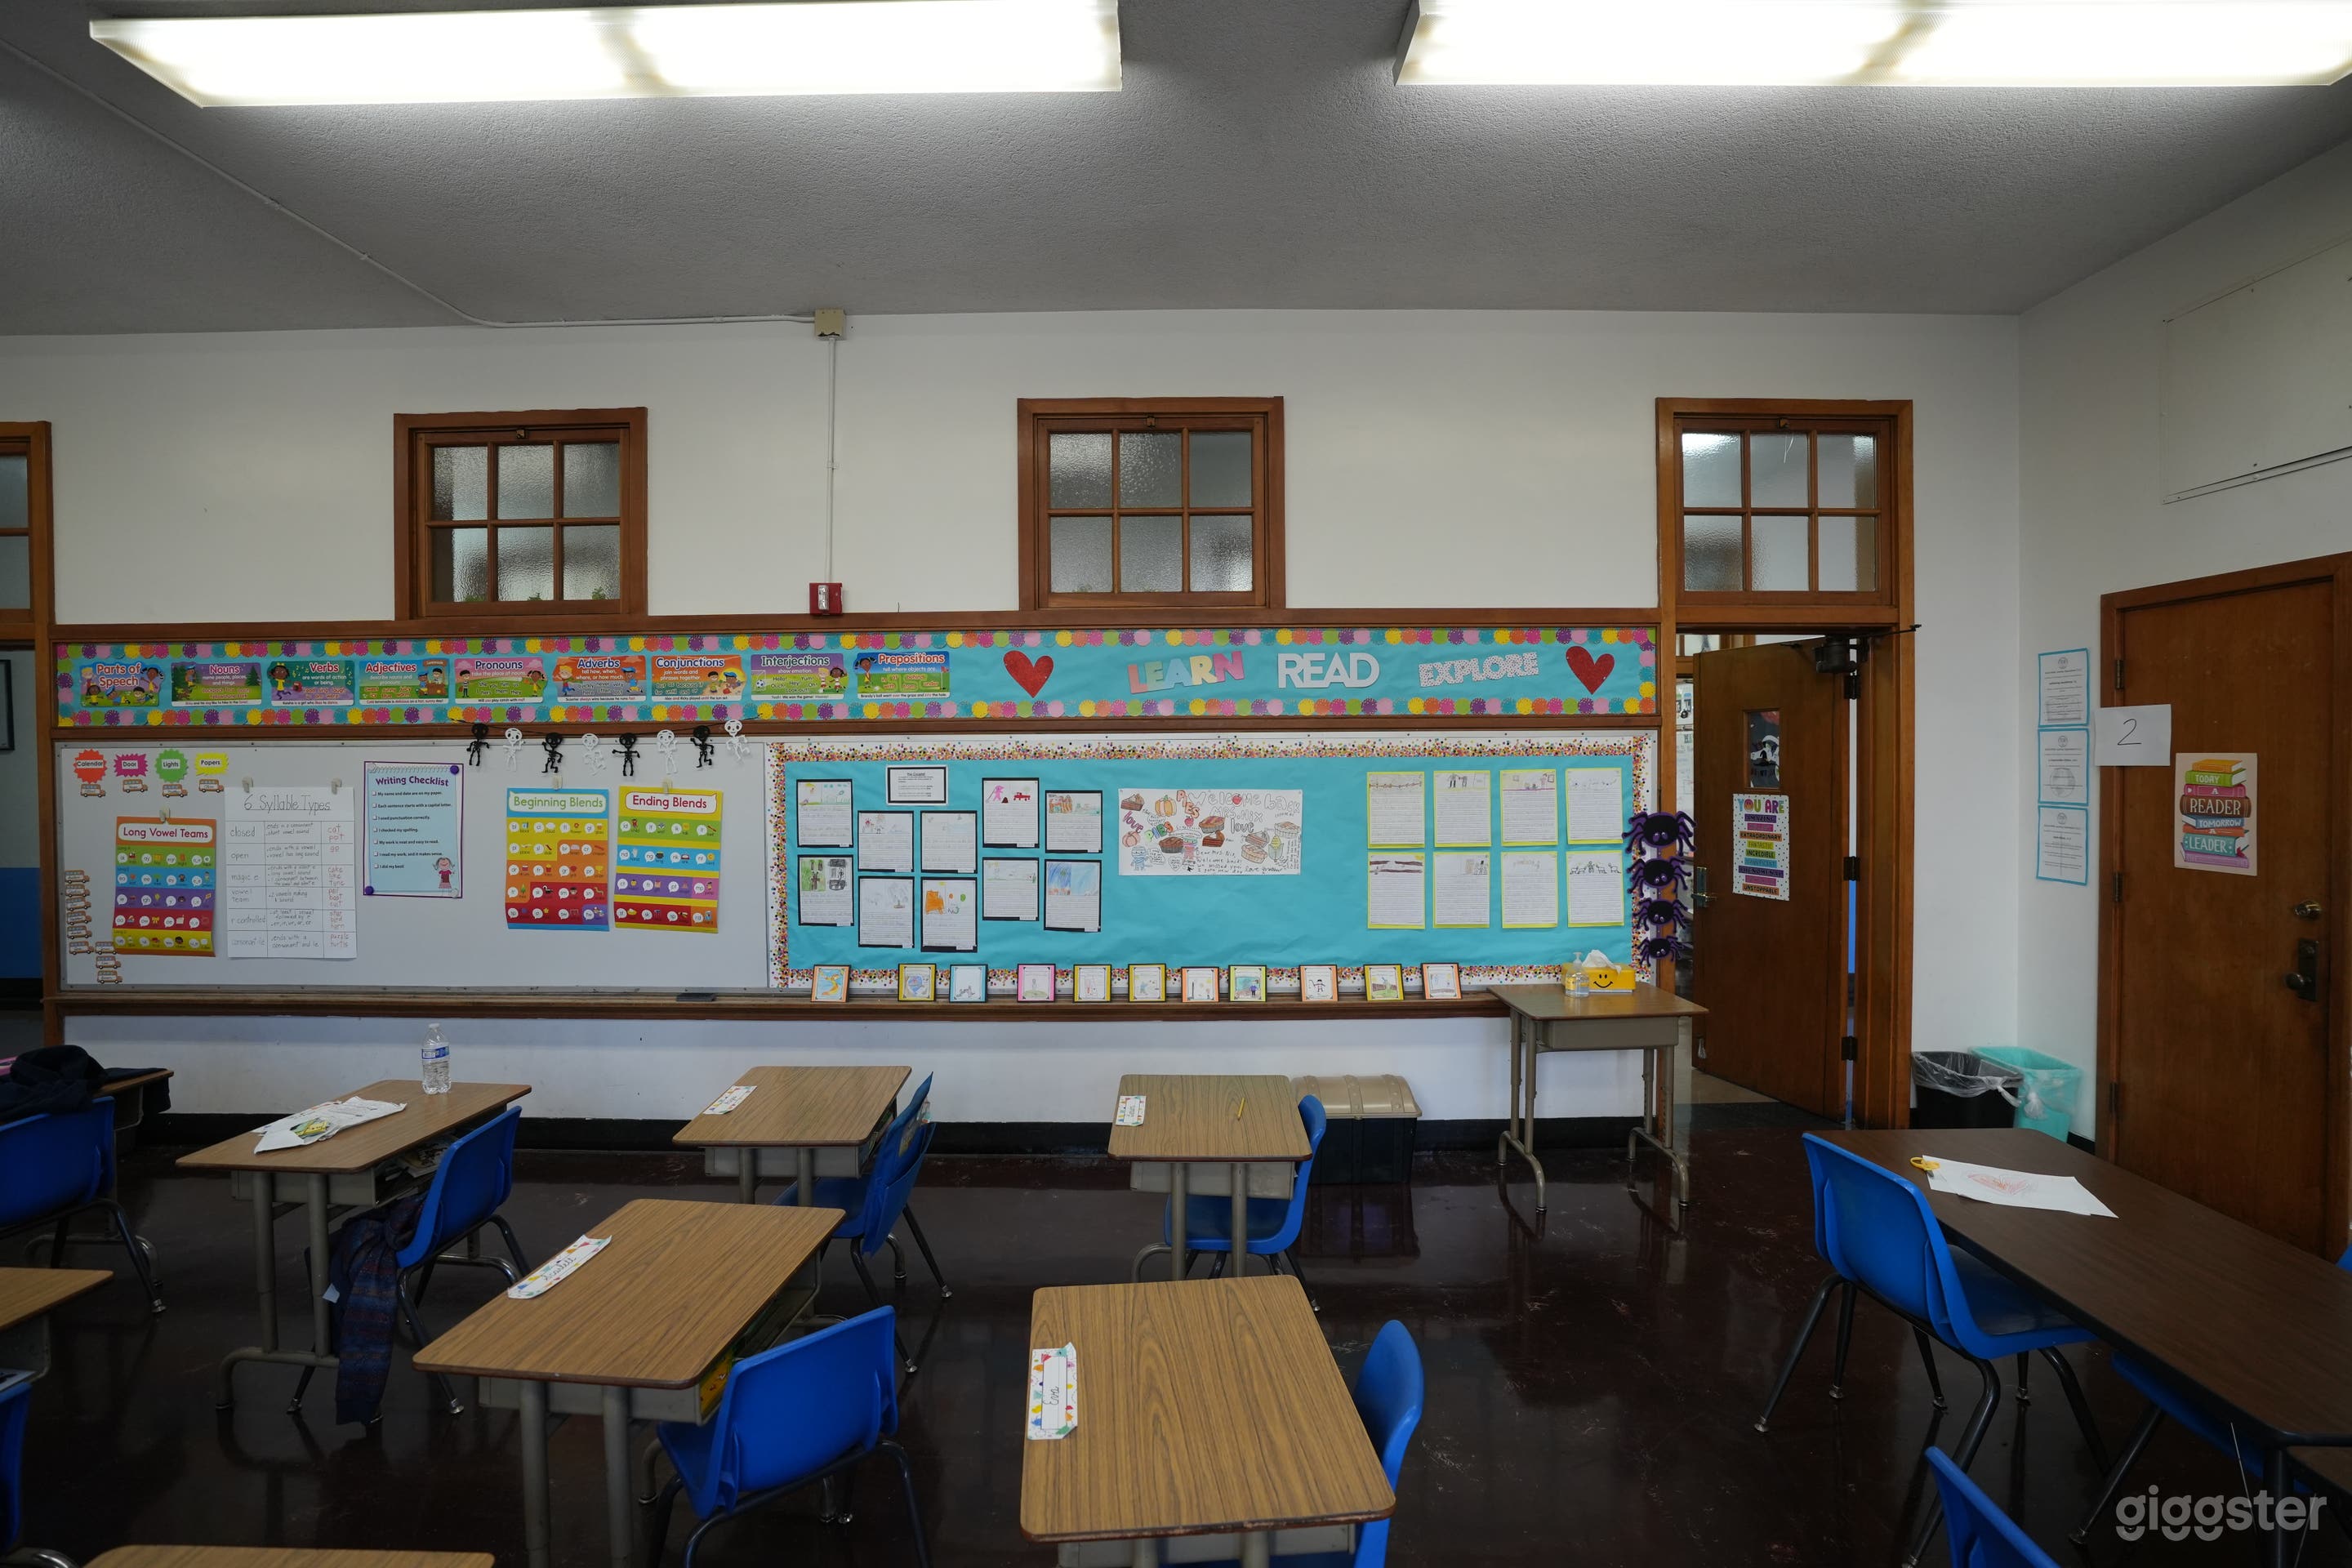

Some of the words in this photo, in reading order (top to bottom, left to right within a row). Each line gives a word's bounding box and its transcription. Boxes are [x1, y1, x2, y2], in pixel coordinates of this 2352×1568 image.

[578, 658, 620, 668] Adverbs
[657, 657, 724, 669] Conjunctions
[761, 655, 830, 667] Interjections
[879, 653, 945, 666] Prepositions
[96, 663, 126, 675] Parts
[128, 663, 141, 674] of
[210, 665, 240, 674] Nouns
[310, 663, 339, 672] Verbs
[366, 663, 416, 674] Adjectives
[475, 661, 523, 670] Pronouns
[1128, 650, 1245, 693] LEARN
[1277, 652, 1380, 688] READ
[1419, 653, 1539, 688] EXPLORE
[100, 675, 139, 688] Speech
[2118, 719, 2142, 745] 2
[376, 777, 407, 786] Writing
[409, 776, 448, 786] Checklist
[2195, 773, 2220, 784] TODAY
[244, 794, 253, 810] 6
[260, 795, 299, 813] Syllable
[301, 795, 331, 815] Types
[514, 796, 566, 809] Beginning
[570, 796, 603, 808] Blends
[633, 795, 669, 808] Ending
[673, 797, 707, 808] Blends
[1738, 798, 1762, 813] YOU
[1765, 800, 1784, 814] ARE
[2189, 798, 2241, 815] READER
[1122, 811, 1143, 832] love
[1231, 818, 1254, 833] love
[2198, 818, 2242, 827] TOMORROW
[123, 827, 146, 839] Long
[149, 828, 177, 837] Vowel
[180, 829, 208, 838] Teams
[229, 826, 255, 837] closed
[327, 824, 341, 833] cat
[329, 833, 345, 843] pot
[1740, 832, 1781, 840] EXTRAORDINARY
[2189, 835, 2228, 853] LEADER
[1747, 849, 1775, 858] INCREDIBLE
[231, 875, 251, 884] magic
[1744, 884, 1778, 893] UNSTOPPABLE
[237, 915, 265, 924] controlled
